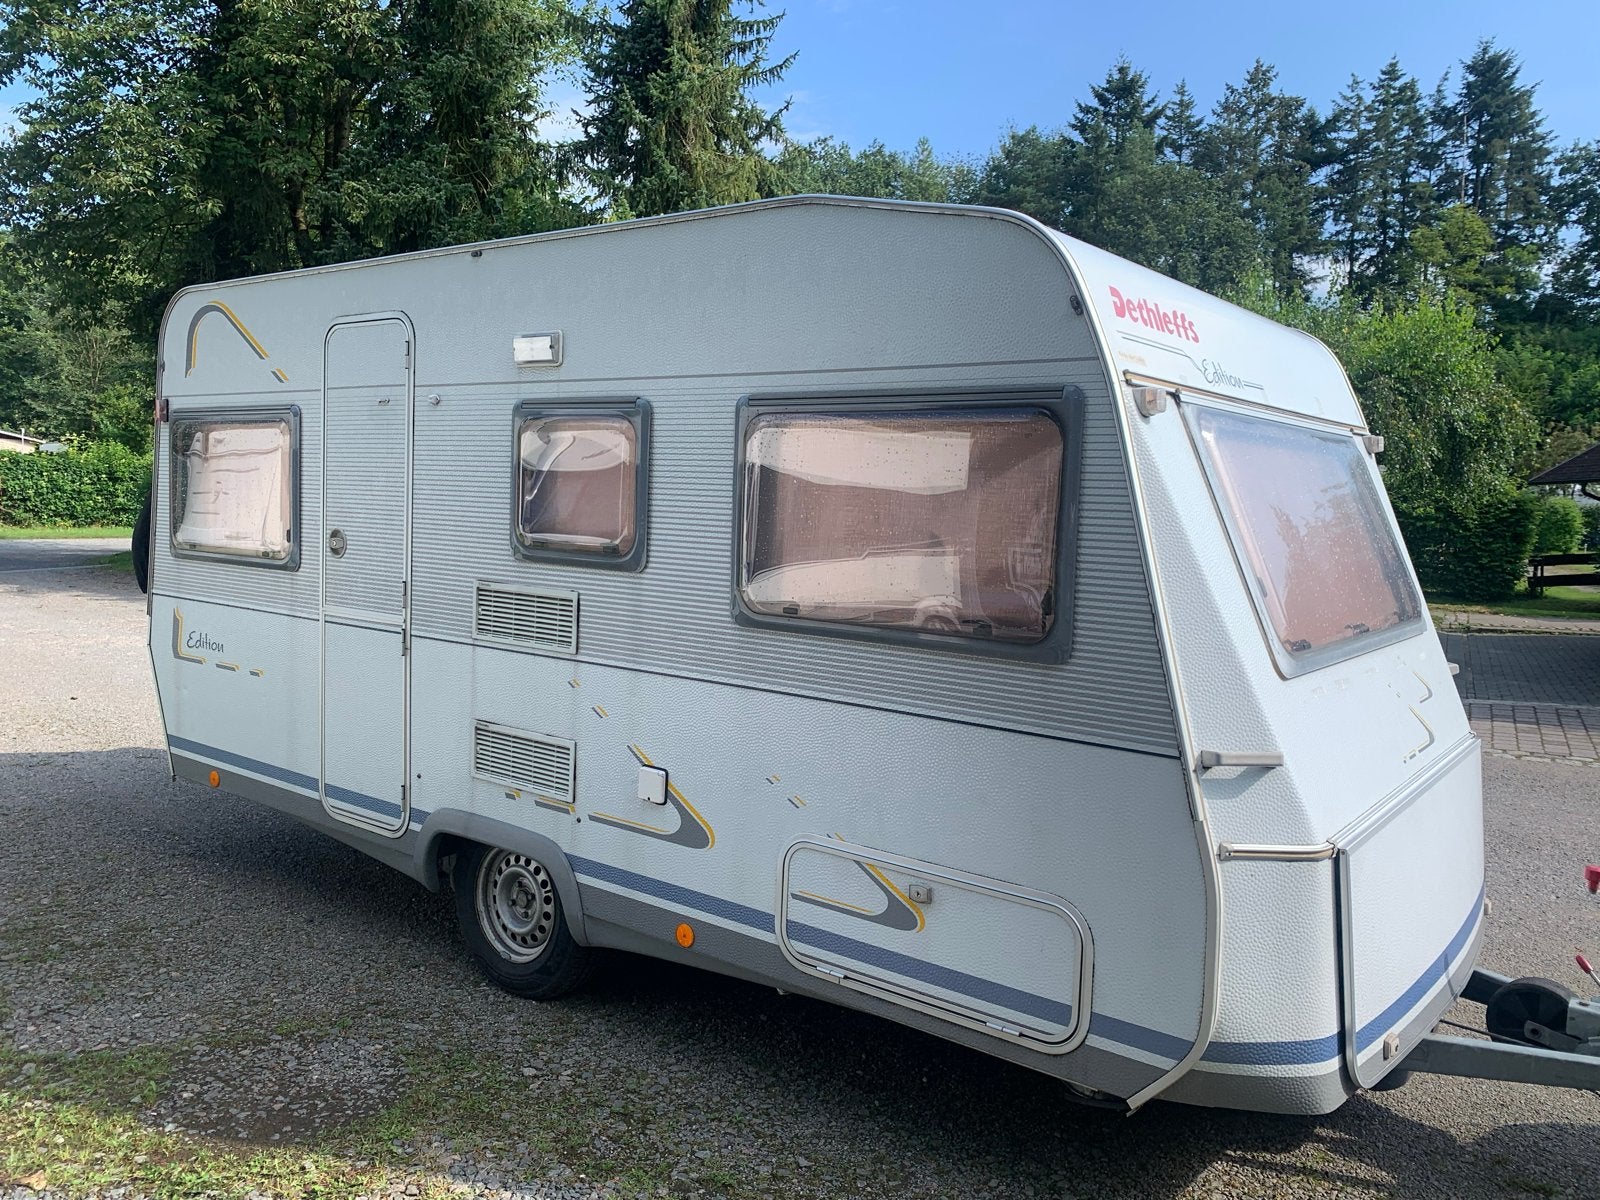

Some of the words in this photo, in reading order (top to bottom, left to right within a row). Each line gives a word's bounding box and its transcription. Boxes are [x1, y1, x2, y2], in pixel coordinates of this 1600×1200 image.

[1108, 285, 1200, 344] Dethleffs
[1201, 358, 1244, 389] Edition
[186, 630, 224, 653] Edition
